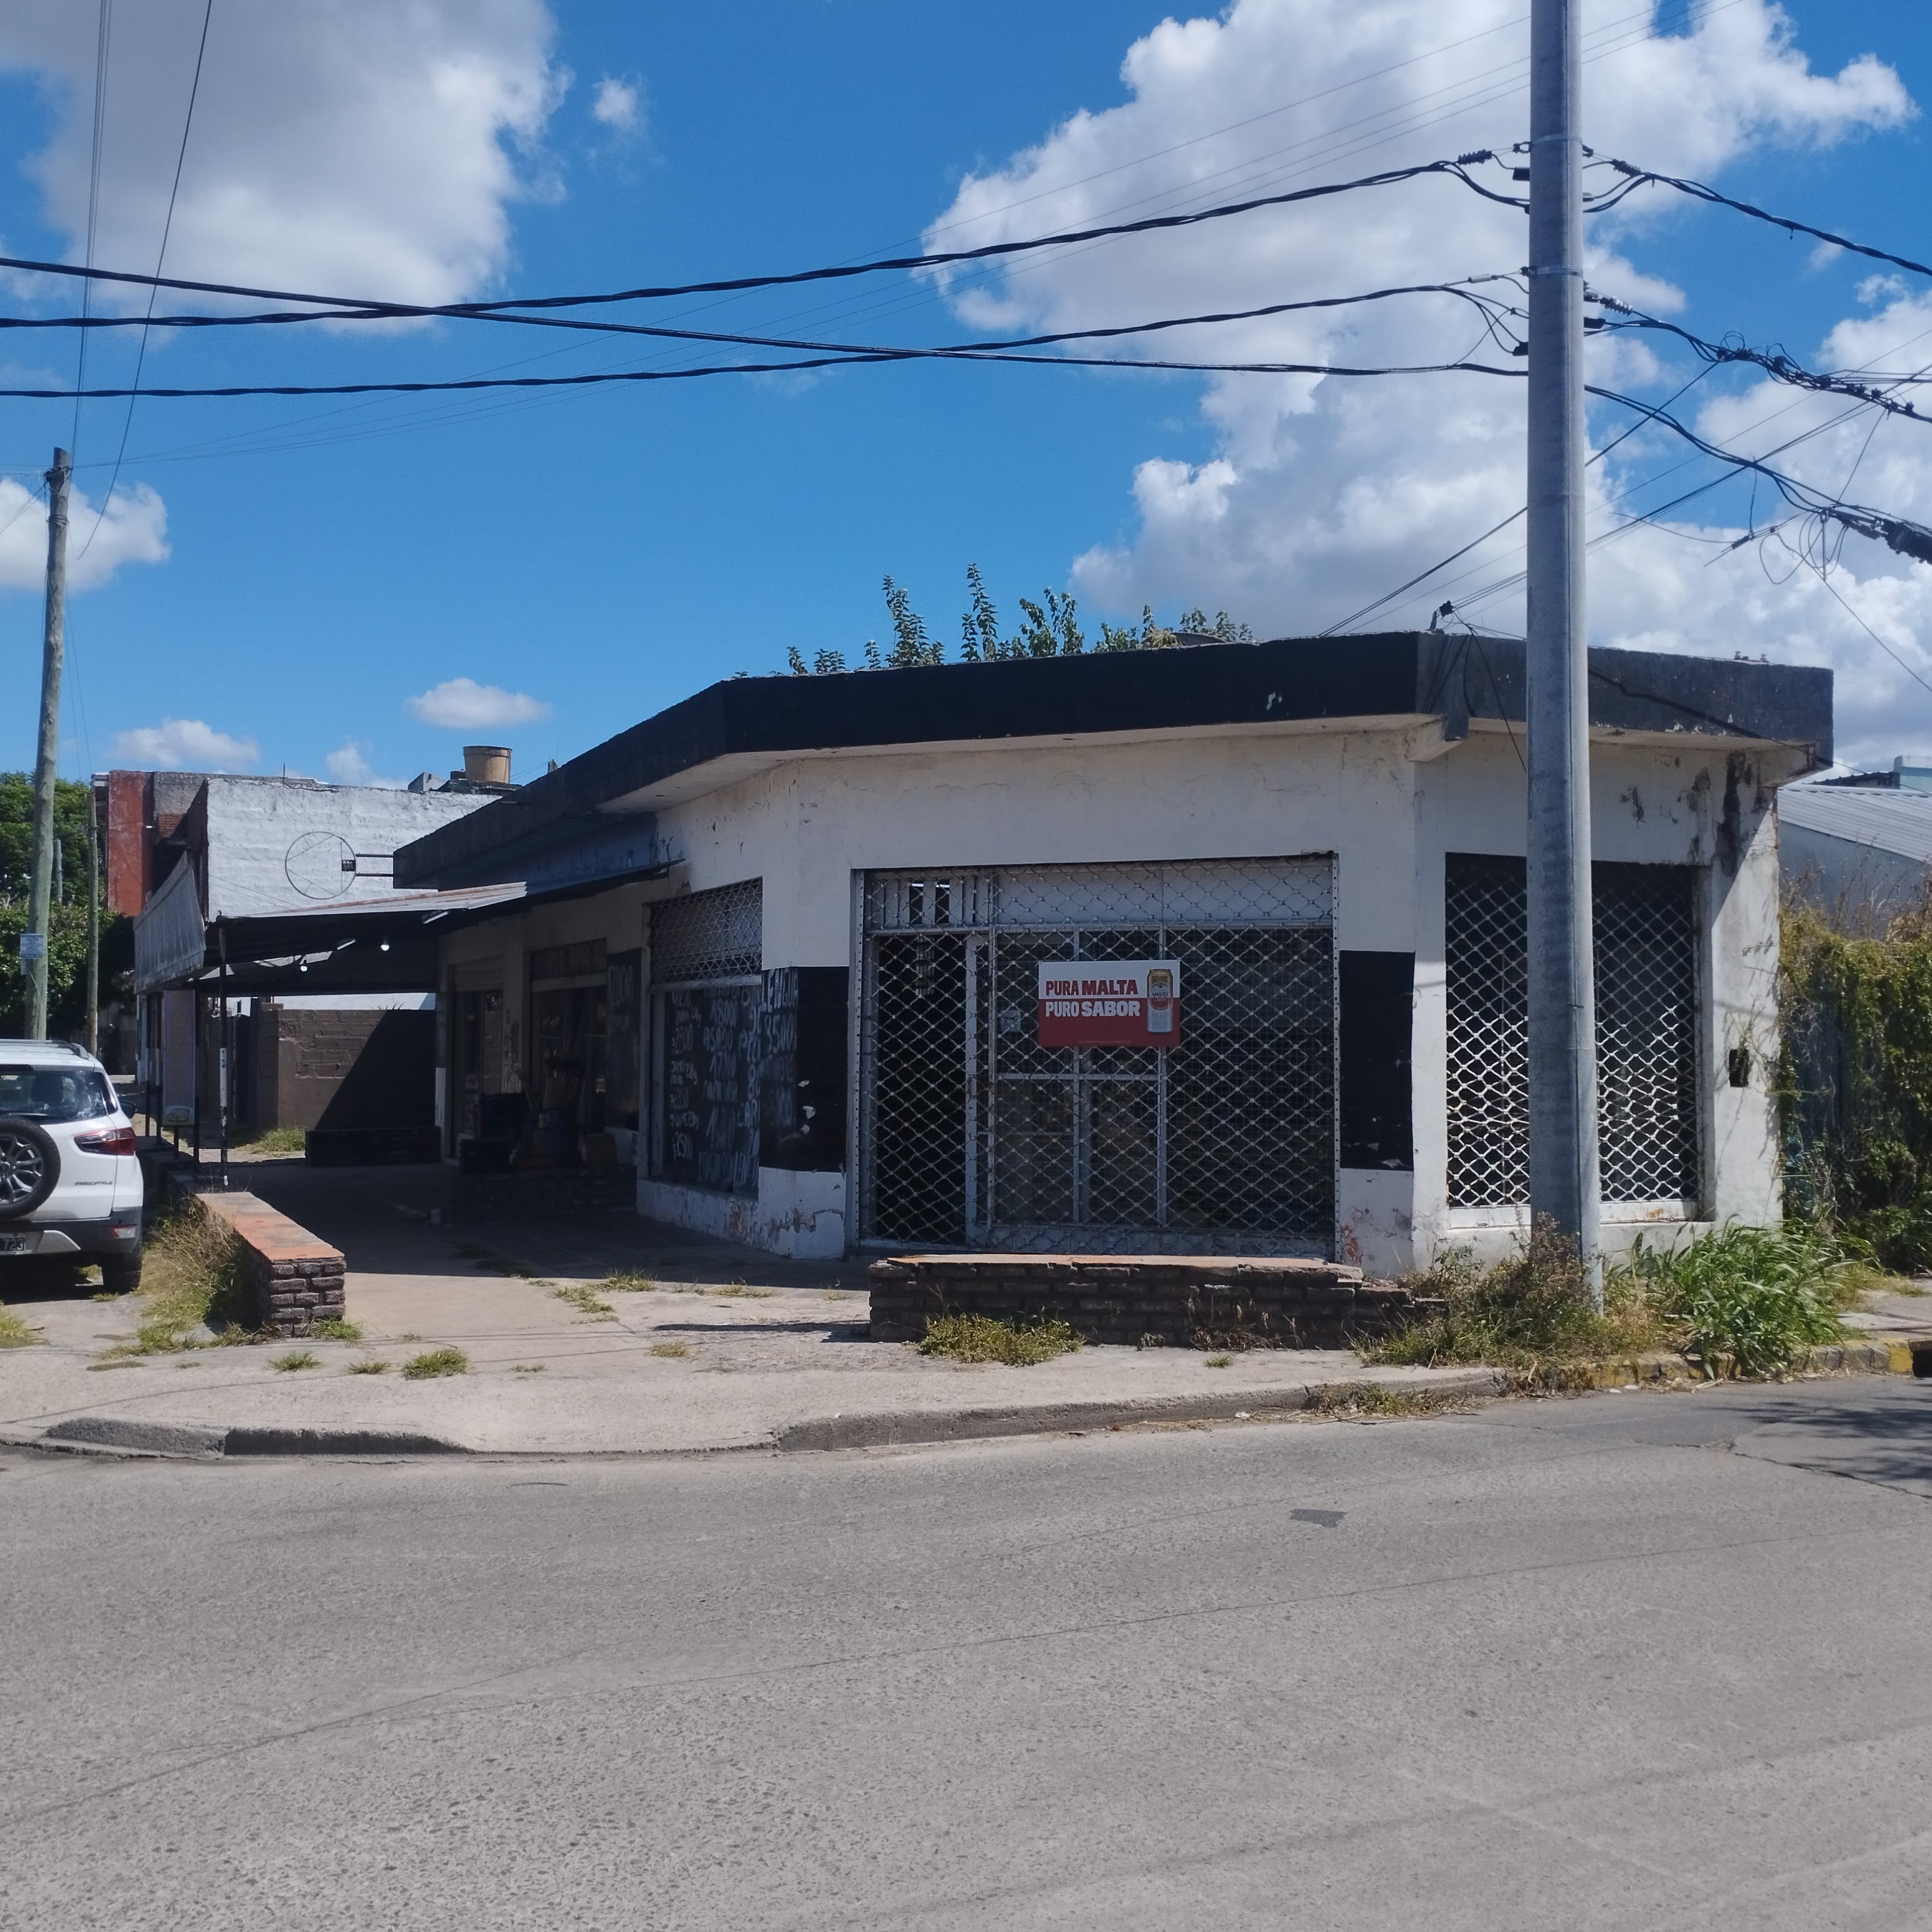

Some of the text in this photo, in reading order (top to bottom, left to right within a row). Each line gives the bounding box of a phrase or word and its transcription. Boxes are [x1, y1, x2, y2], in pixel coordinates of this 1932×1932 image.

[1045, 979, 1138, 996] PURA MALTA
[1045, 1001, 1140, 1017] PURO SABOR
[3, 1238, 24, 1251] 723
